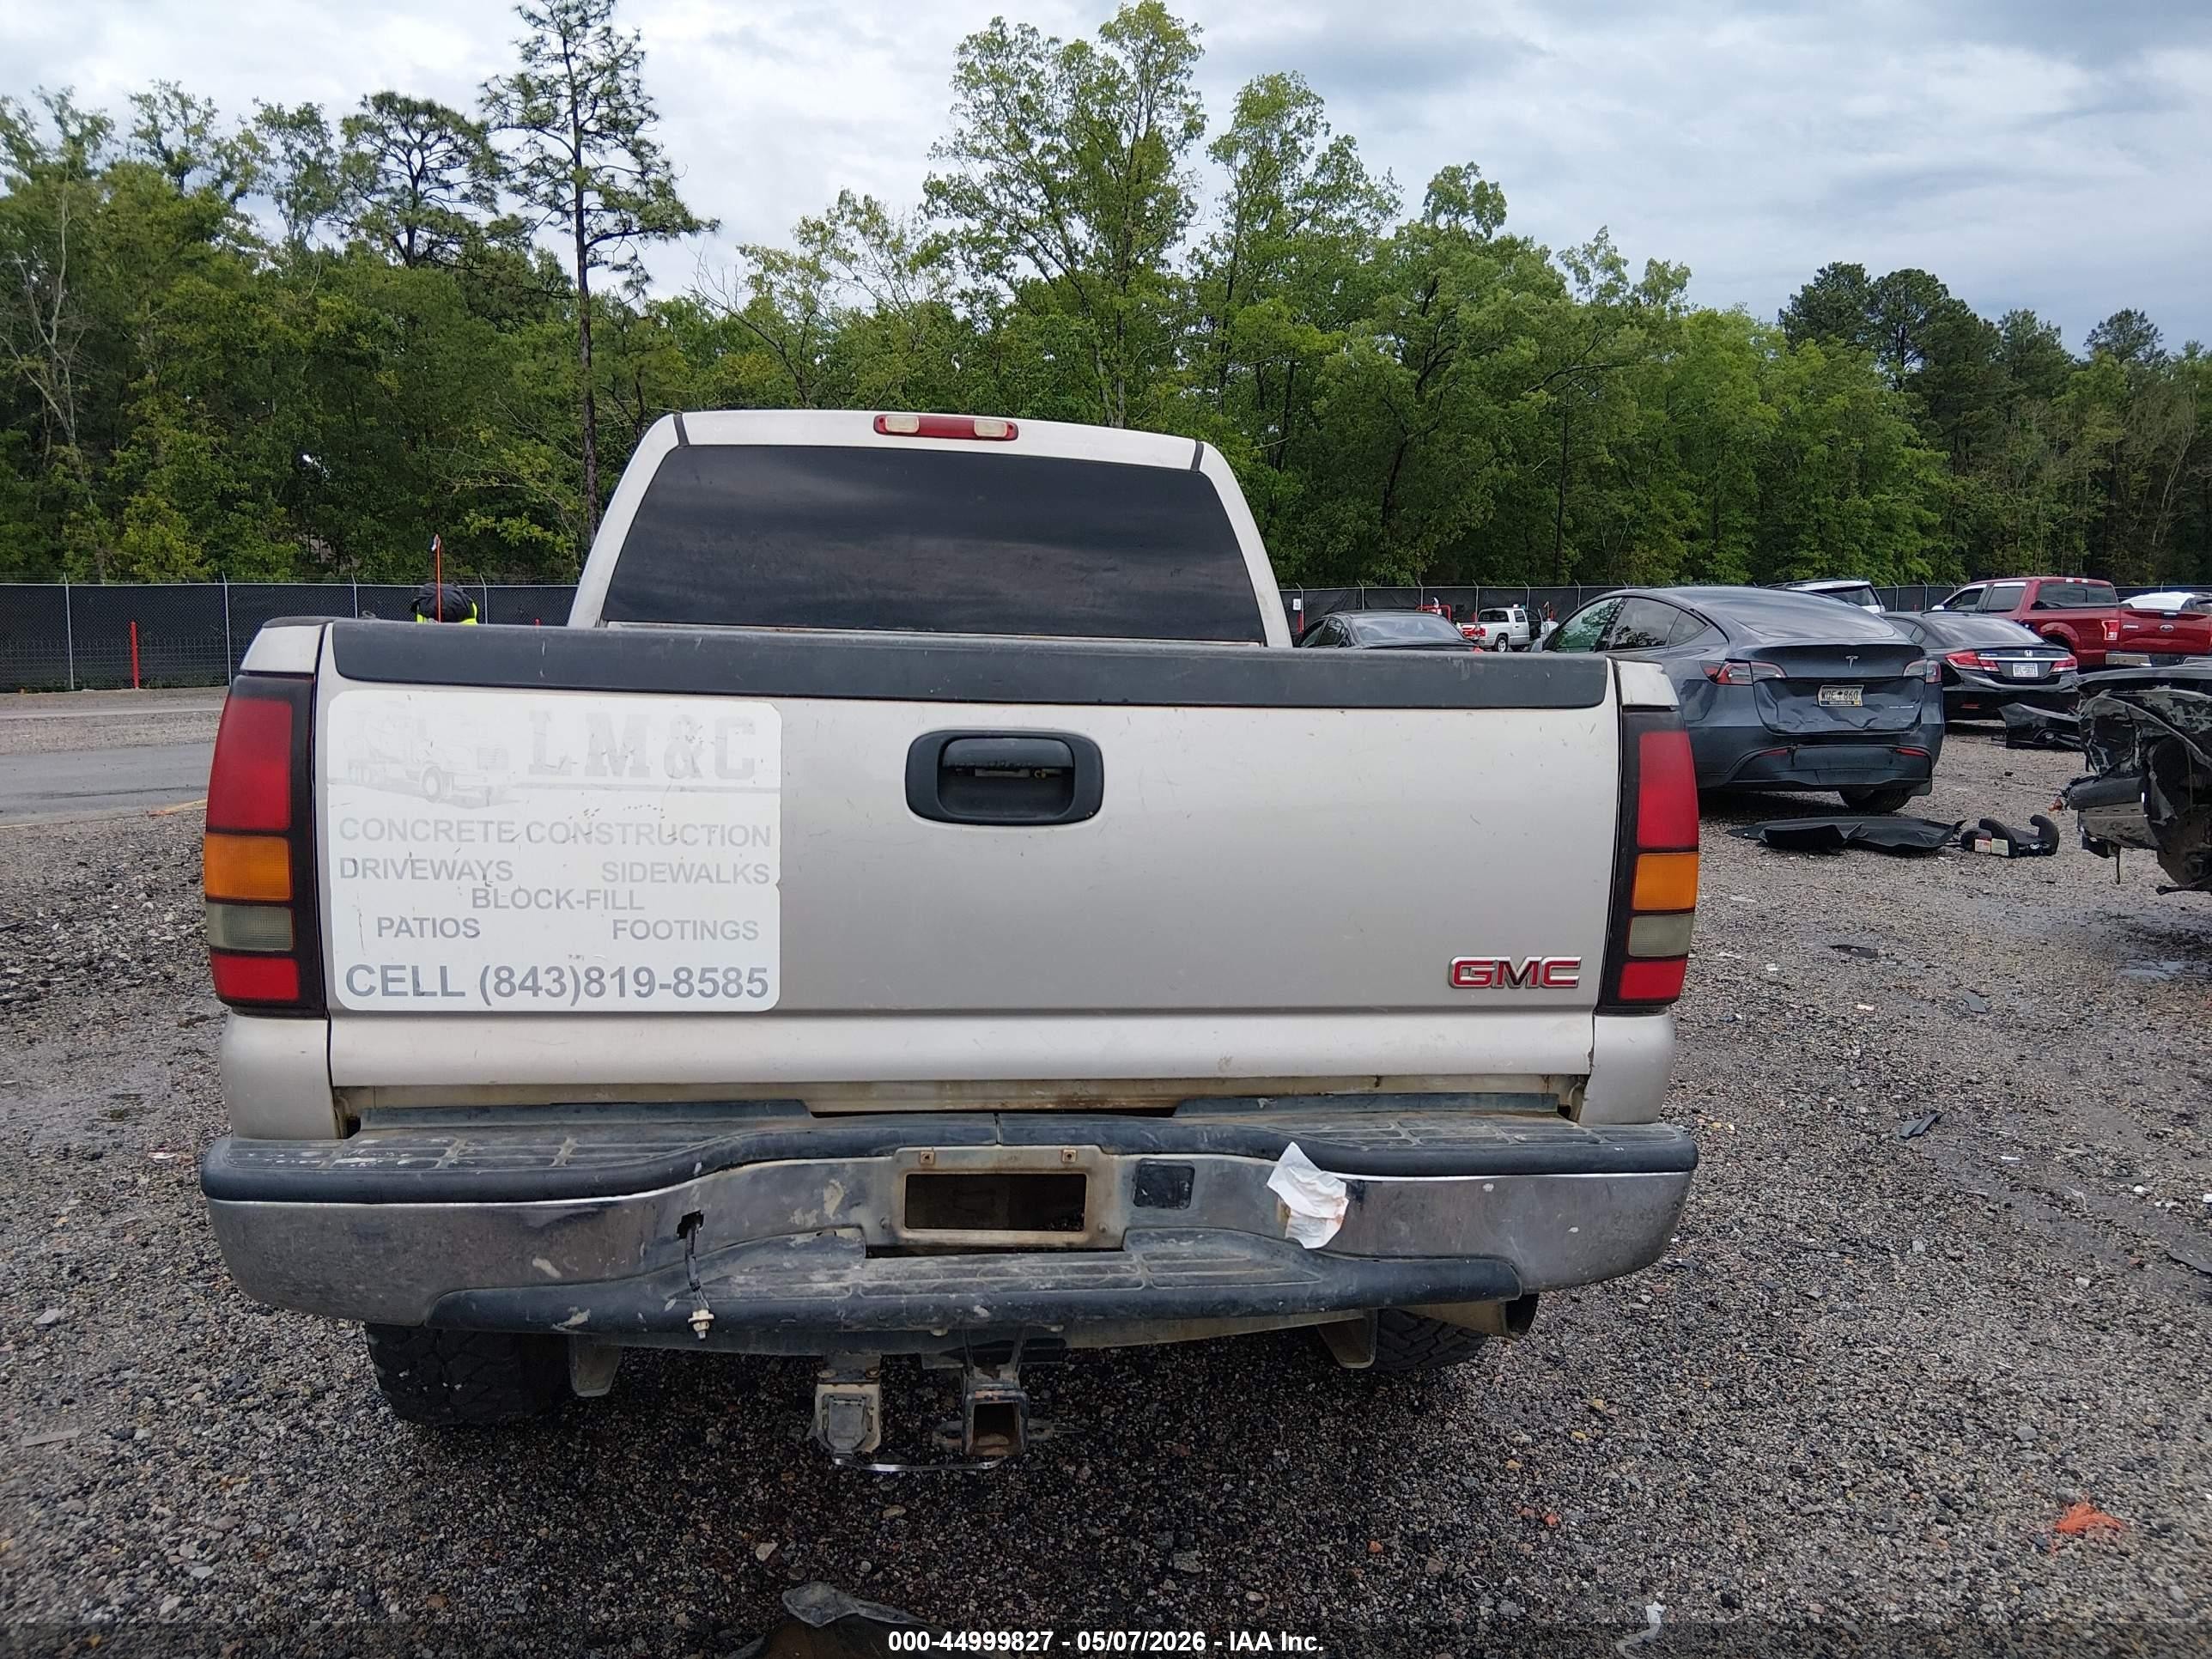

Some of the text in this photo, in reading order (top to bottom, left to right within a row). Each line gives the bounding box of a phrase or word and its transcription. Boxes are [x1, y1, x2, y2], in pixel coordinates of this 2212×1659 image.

[338, 817, 772, 848] CONCRETE CONSTRUCTION
[338, 857, 514, 882] DRIVEWAYS
[601, 861, 770, 885] SIDEWALKS
[471, 887, 645, 911] BLOCK-FILL
[376, 916, 481, 939] PATIOS
[611, 918, 759, 942] FOOTINGS
[344, 963, 769, 1006] CELL (843)819-8585
[1449, 956, 1582, 989] GMC
